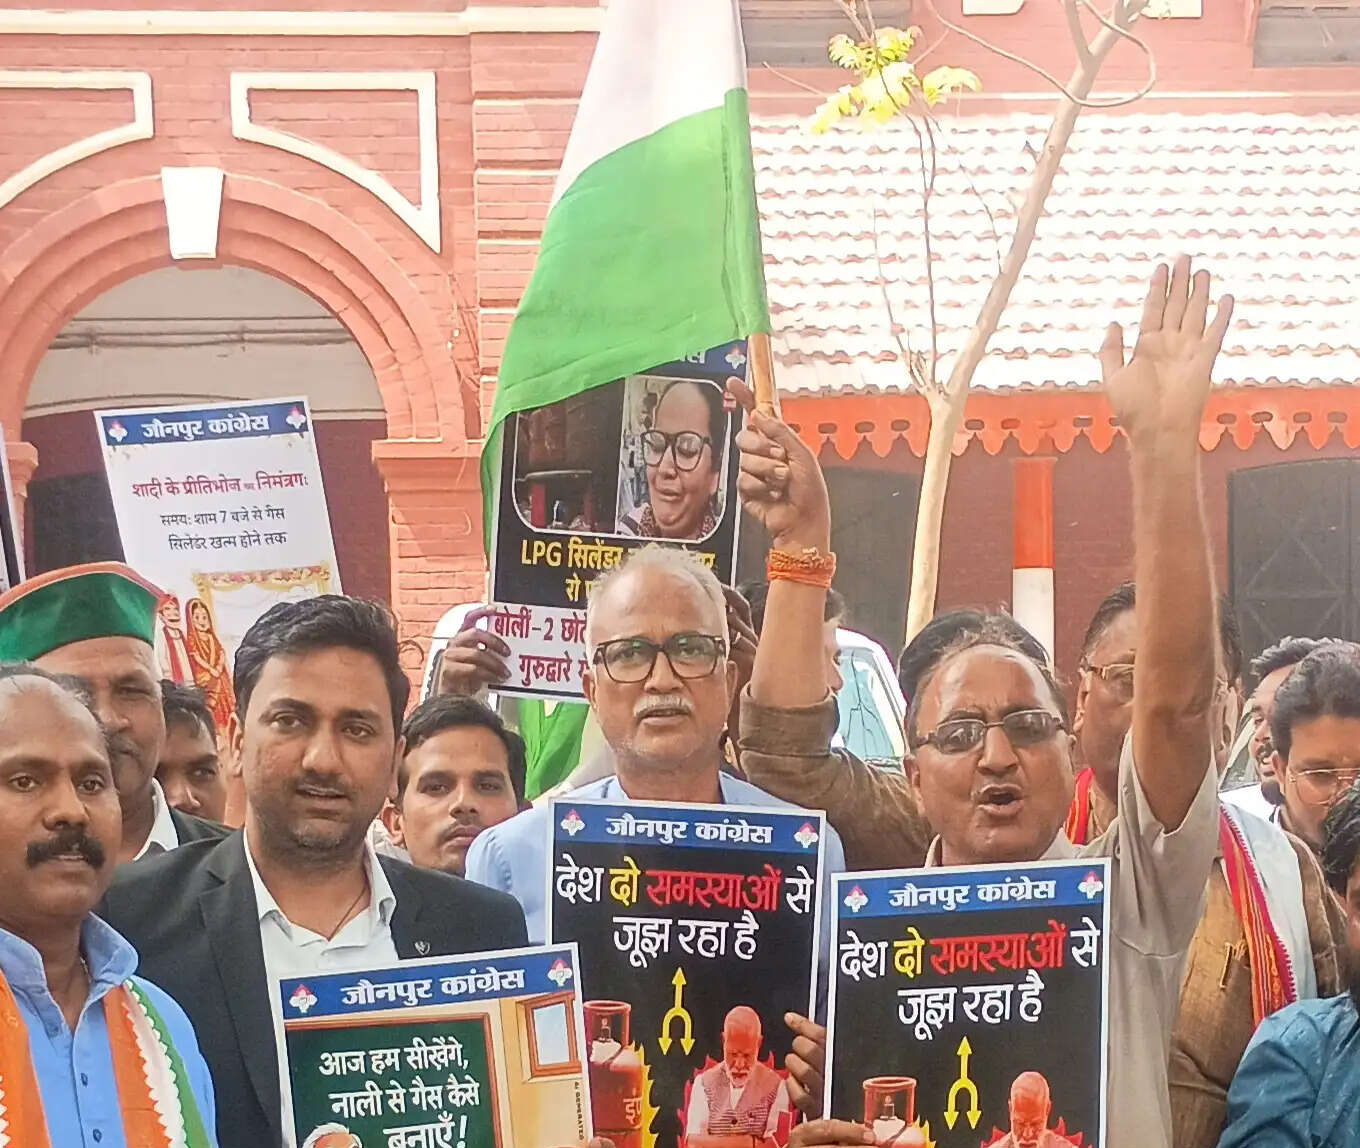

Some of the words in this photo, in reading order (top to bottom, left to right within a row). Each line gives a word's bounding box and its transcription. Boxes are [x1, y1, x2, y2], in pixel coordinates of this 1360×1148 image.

[141, 416, 204, 441] जौनपुर
[208, 413, 270, 434] कांग्रेस
[132, 477, 163, 499] शादी
[164, 476, 180, 496] के
[182, 473, 241, 495] प्रीतिभोज
[194, 512, 217, 525] शाम
[220, 510, 227, 524] 7
[230, 507, 250, 523] बजे
[251, 505, 264, 521] से
[209, 534, 238, 549] खत्म
[239, 529, 261, 549] होने
[264, 531, 287, 545] तक
[522, 540, 561, 567] LPG
[566, 575, 582, 602] रो
[519, 650, 572, 687] गुरुद्वारे
[605, 813, 688, 844] जौनपुर
[694, 818, 773, 844] कांग्रेस
[556, 853, 604, 905] देश
[608, 855, 640, 906] दो
[645, 863, 782, 912] समस्याओं
[785, 865, 814, 913] से
[889, 882, 970, 911] जौनपुर
[976, 875, 1056, 902] कांग्रेस
[612, 915, 673, 968] जूझ
[678, 917, 730, 958] रहा
[733, 909, 760, 960] है
[840, 930, 888, 981] देश
[893, 927, 925, 979] दो
[929, 918, 1068, 976] समस्याओं
[1070, 917, 1101, 968] से
[340, 978, 433, 1007] जौनपुर
[440, 967, 525, 995] कांग्रेस
[897, 987, 957, 1041] जूझ
[962, 983, 1013, 1024] रहा
[1018, 968, 1044, 1023] है
[319, 1051, 366, 1076] आज
[369, 1048, 400, 1075] हम
[328, 1081, 383, 1119] नाली
[385, 1079, 406, 1114] से
[409, 1075, 443, 1111] गैस
[446, 1073, 480, 1107] कैसे
